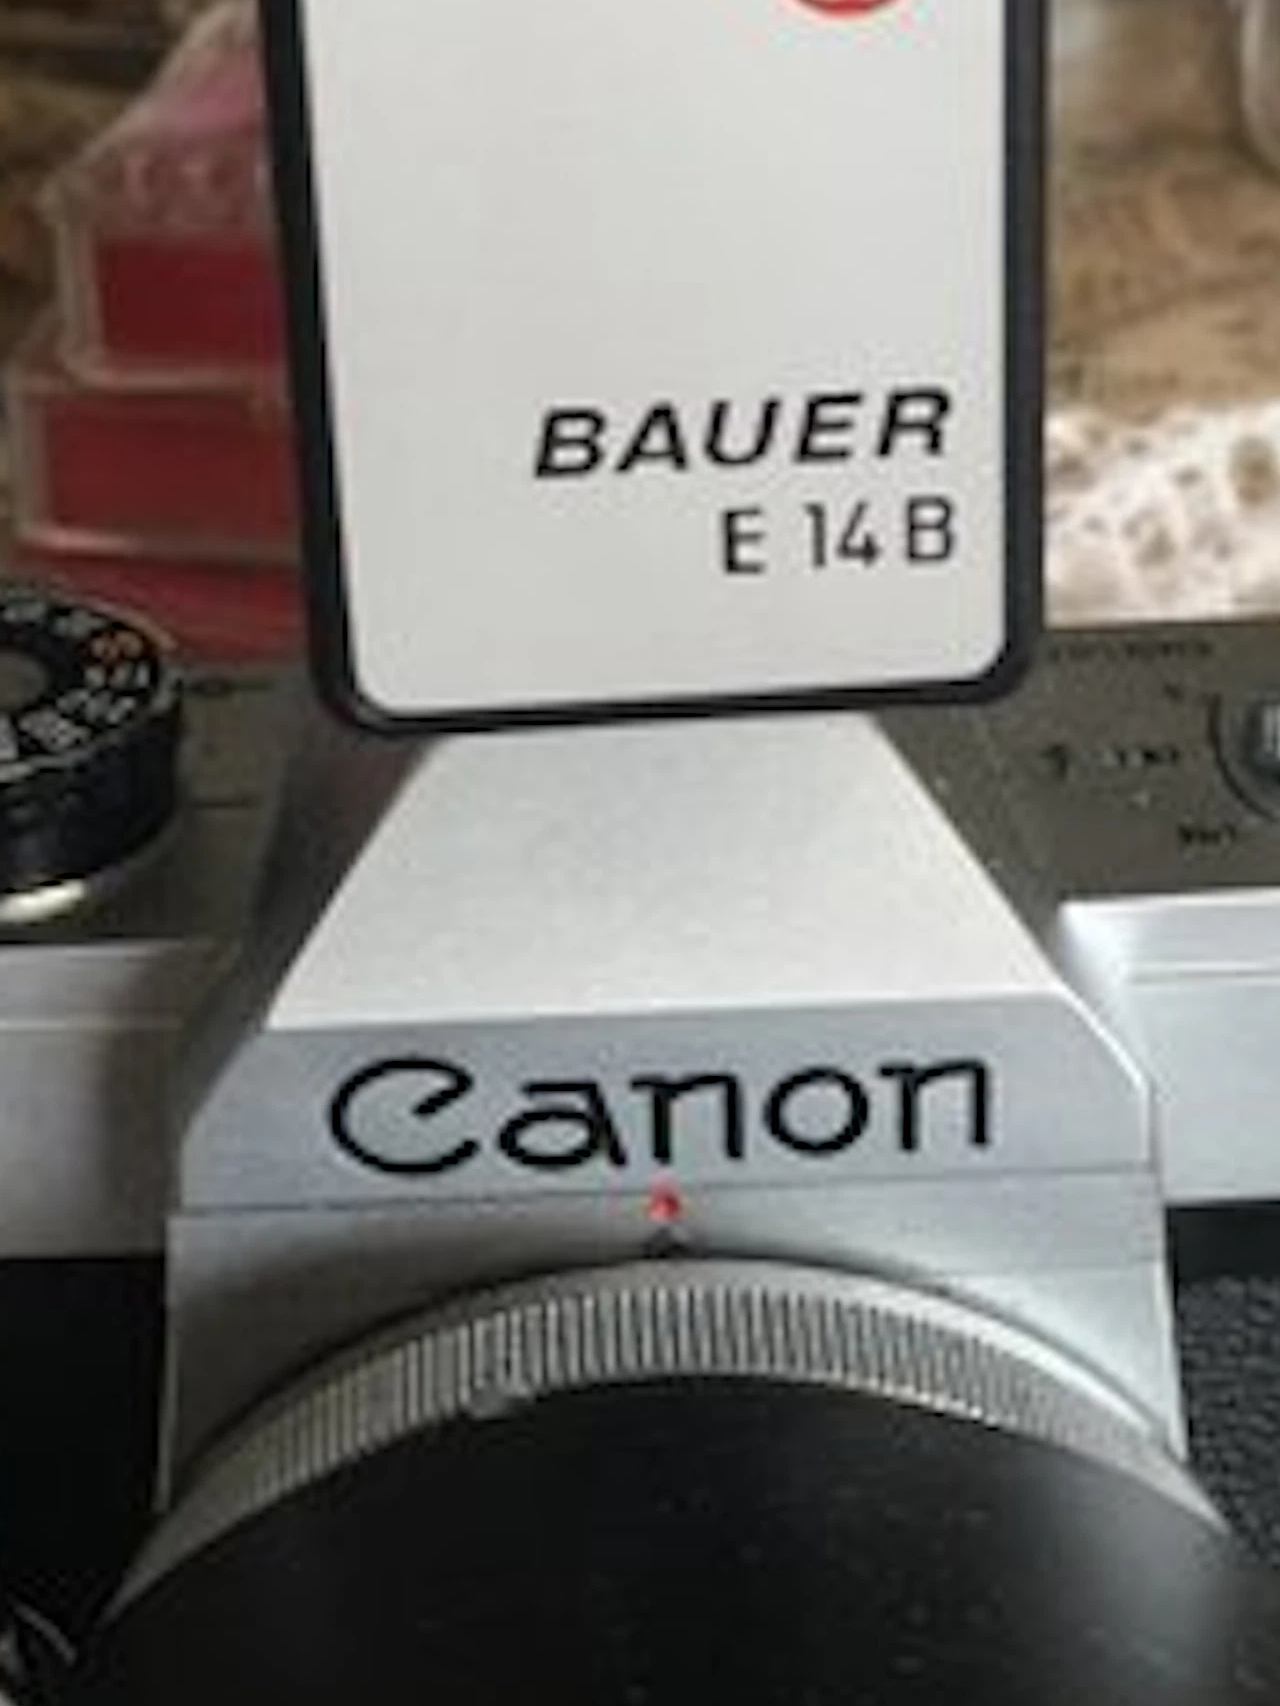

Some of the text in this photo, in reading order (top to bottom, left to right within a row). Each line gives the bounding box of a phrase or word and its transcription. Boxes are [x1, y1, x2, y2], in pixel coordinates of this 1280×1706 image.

[532, 386, 954, 480] BAUER
[723, 503, 767, 576] E
[328, 1056, 992, 1175] Canon
